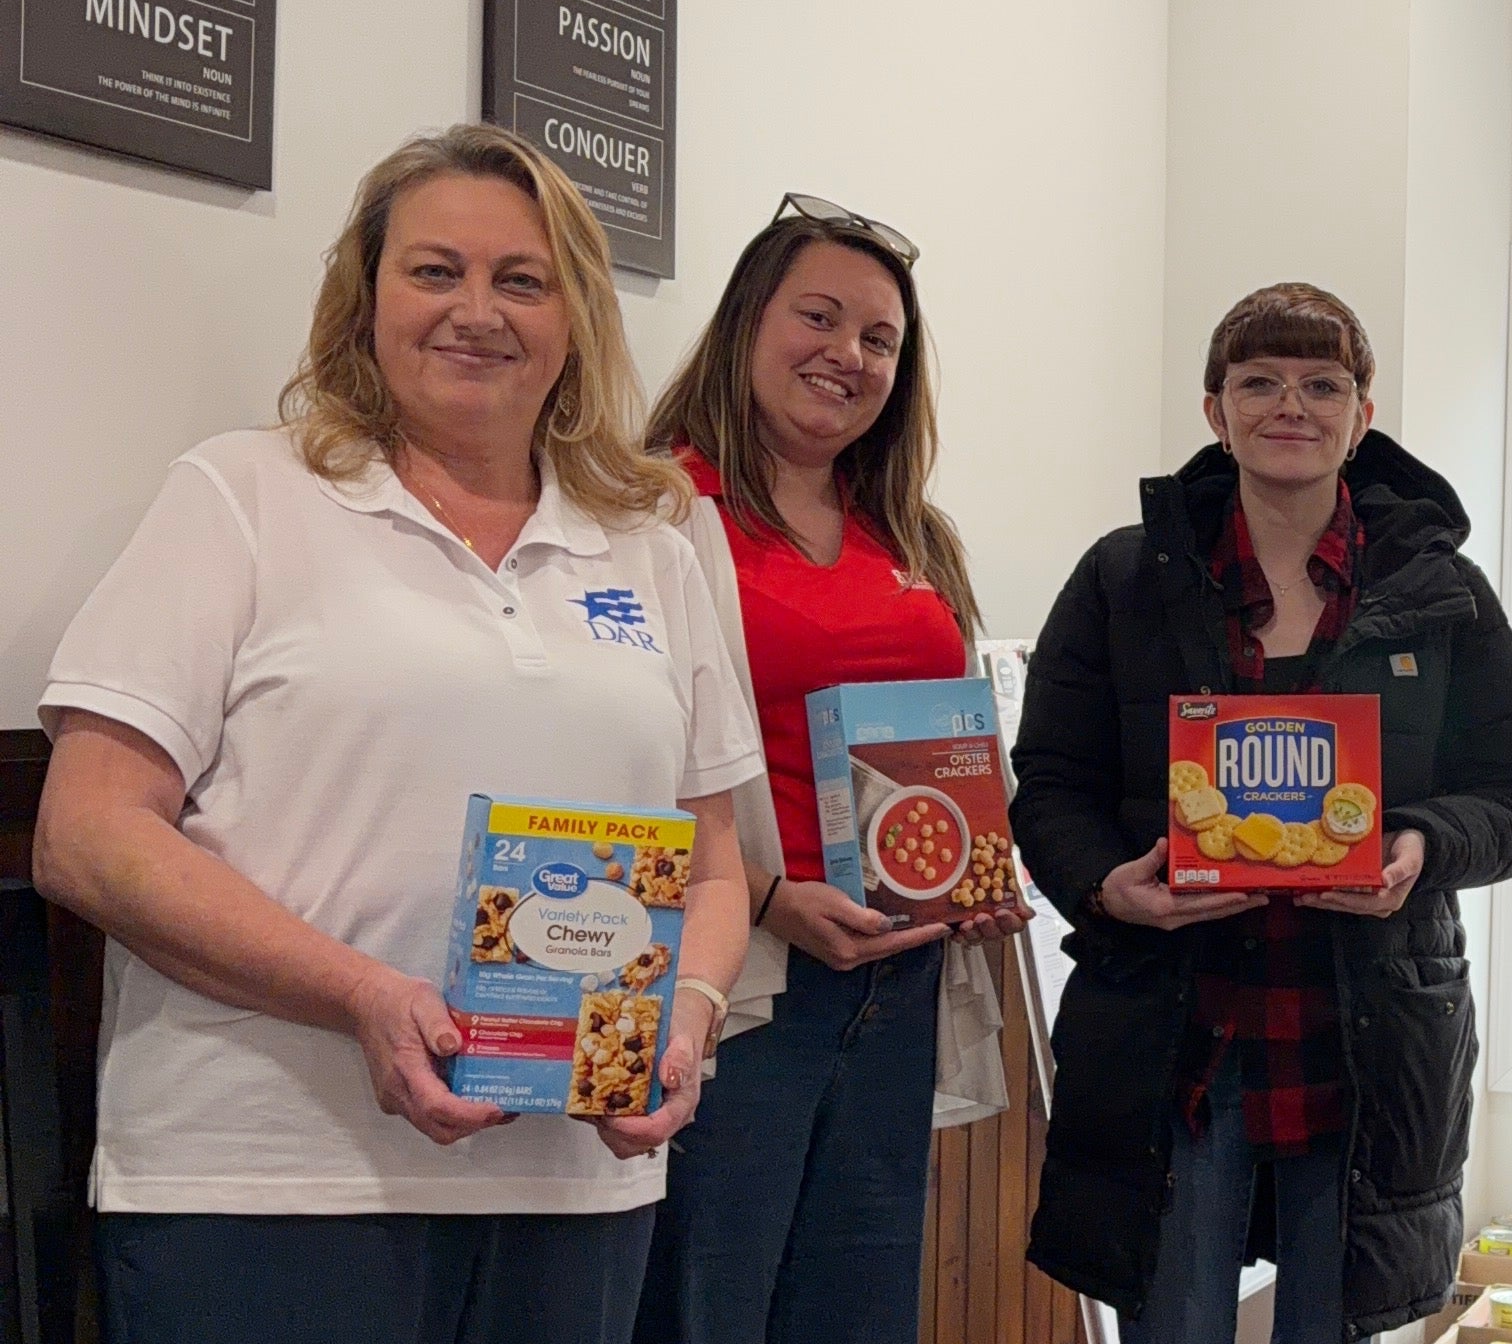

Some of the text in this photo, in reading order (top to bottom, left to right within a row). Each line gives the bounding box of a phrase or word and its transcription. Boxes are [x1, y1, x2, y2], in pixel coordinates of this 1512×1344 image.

[559, 6, 650, 68] PASSION
[203, 67, 232, 85] NOUN
[631, 69, 650, 84] NOUN
[141, 69, 231, 103] THINK IT INTO EXISTENCE
[98, 75, 231, 120] THE POWER OF THE MIND IS INFINITE
[545, 118, 649, 177] CONQUER
[593, 187, 604, 198] AND
[605, 190, 617, 203] TAKE
[618, 193, 639, 207] CONTROL
[631, 182, 648, 195] VERB
[584, 620, 664, 654] DAR
[1245, 721, 1305, 733] GOLDEN
[950, 753, 991, 765] OYSTER
[1219, 735, 1331, 788] ROUND
[934, 764, 992, 779] CRACKERS
[1243, 791, 1306, 801] CRACKERS
[528, 815, 660, 840] FAMILY PACK
[494, 839, 526, 862] 24
[539, 869, 580, 885] Great
[548, 882, 577, 893] Value
[538, 908, 628, 926] Variety Pack
[546, 925, 615, 947] Chewy
[545, 945, 612, 957] Granola Bars
[471, 1015, 479, 1025] 9
[470, 1029, 477, 1039] 9
[467, 1044, 475, 1054] 6
